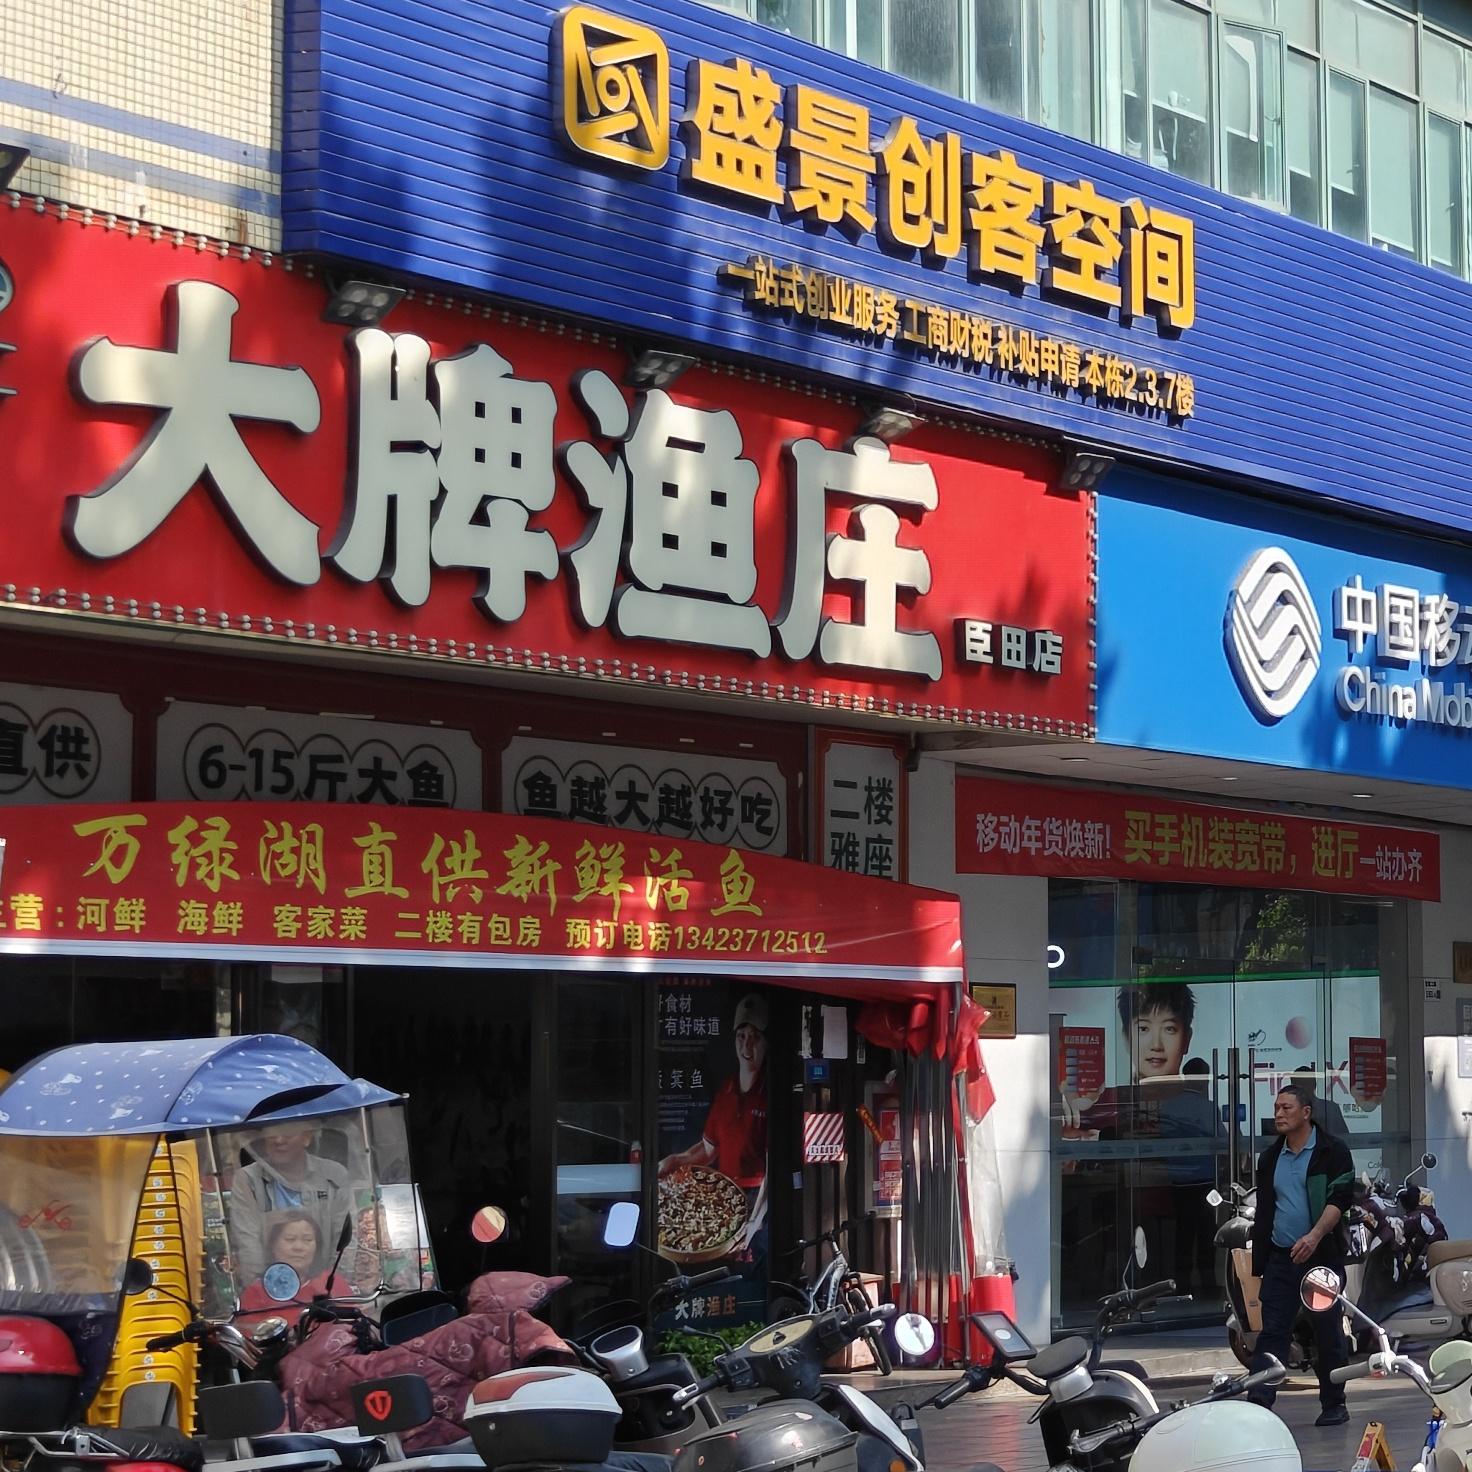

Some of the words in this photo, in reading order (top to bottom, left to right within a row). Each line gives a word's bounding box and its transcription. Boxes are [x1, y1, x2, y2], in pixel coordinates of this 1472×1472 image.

[683, 57, 1196, 330] 盛景创客空间
[723, 255, 900, 341] 一站式创业服务
[902, 300, 995, 366] 工商财税
[997, 327, 1081, 388] 补贴申请
[62, 279, 942, 682] 大牌渔庄
[956, 618, 1063, 674] 臣田店
[1339, 665, 1418, 720] China
[197, 744, 450, 805] 6-15斤大鱼
[522, 760, 776, 837] 鱼越大越好吃
[829, 776, 895, 827] 二楼
[72, 814, 765, 919] 万绿湖直供新鲜活鱼
[829, 831, 895, 880] 雅座
[975, 812, 1112, 860] 移动年货焕新!
[1124, 808, 1360, 879] 买手机装宽带，进厅
[1360, 848, 1424, 884] 一站办齐
[178, 899, 245, 936] 海鲜
[272, 902, 368, 942] 客家菜
[394, 908, 542, 948] 二楼有包房
[658, 993, 692, 1014] 食材
[658, 1016, 721, 1037] 有好味道
[674, 1295, 737, 1321] 大牌渔庄
